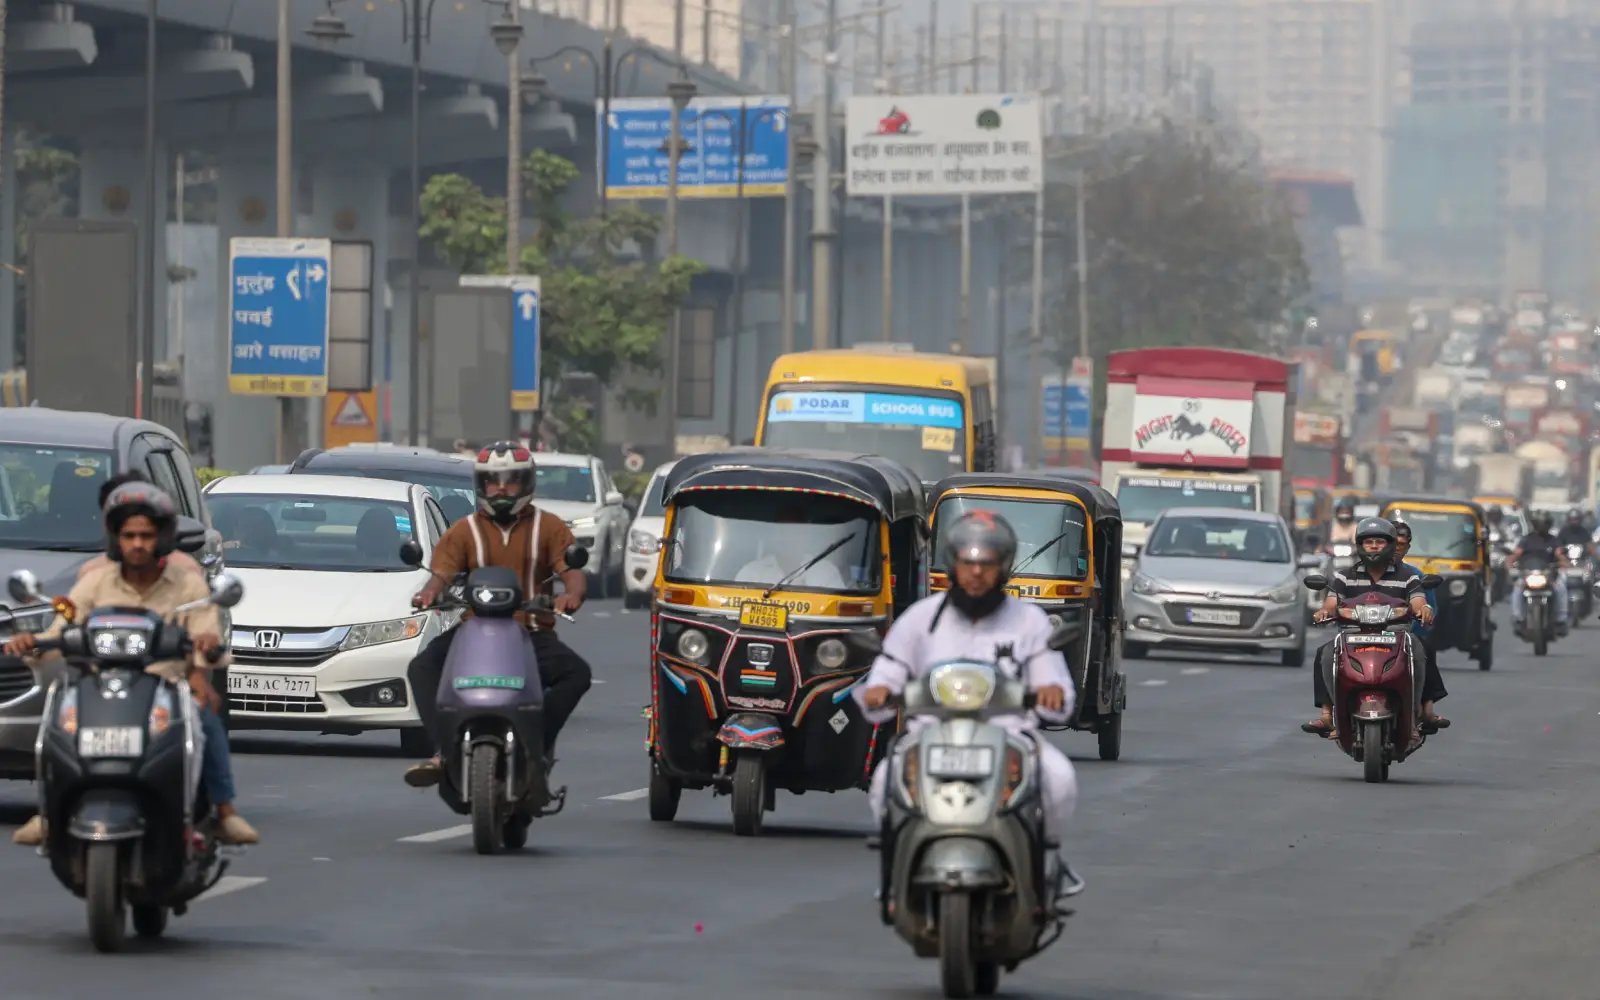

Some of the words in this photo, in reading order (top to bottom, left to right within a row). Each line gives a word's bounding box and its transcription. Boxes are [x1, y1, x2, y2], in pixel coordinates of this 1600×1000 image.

[235, 306, 273, 328] पवई
[234, 340, 263, 359] आरे
[799, 398, 850, 409] PODAR
[871, 402, 925, 416] SCHOOL
[928, 404, 956, 418] BUS
[1135, 415, 1174, 449] NIGHT
[1209, 417, 1247, 454] RIDER
[749, 615, 778, 627] W4909
[246, 678, 259, 689] 48
[263, 679, 281, 690] AC
[284, 680, 310, 692] 7277
